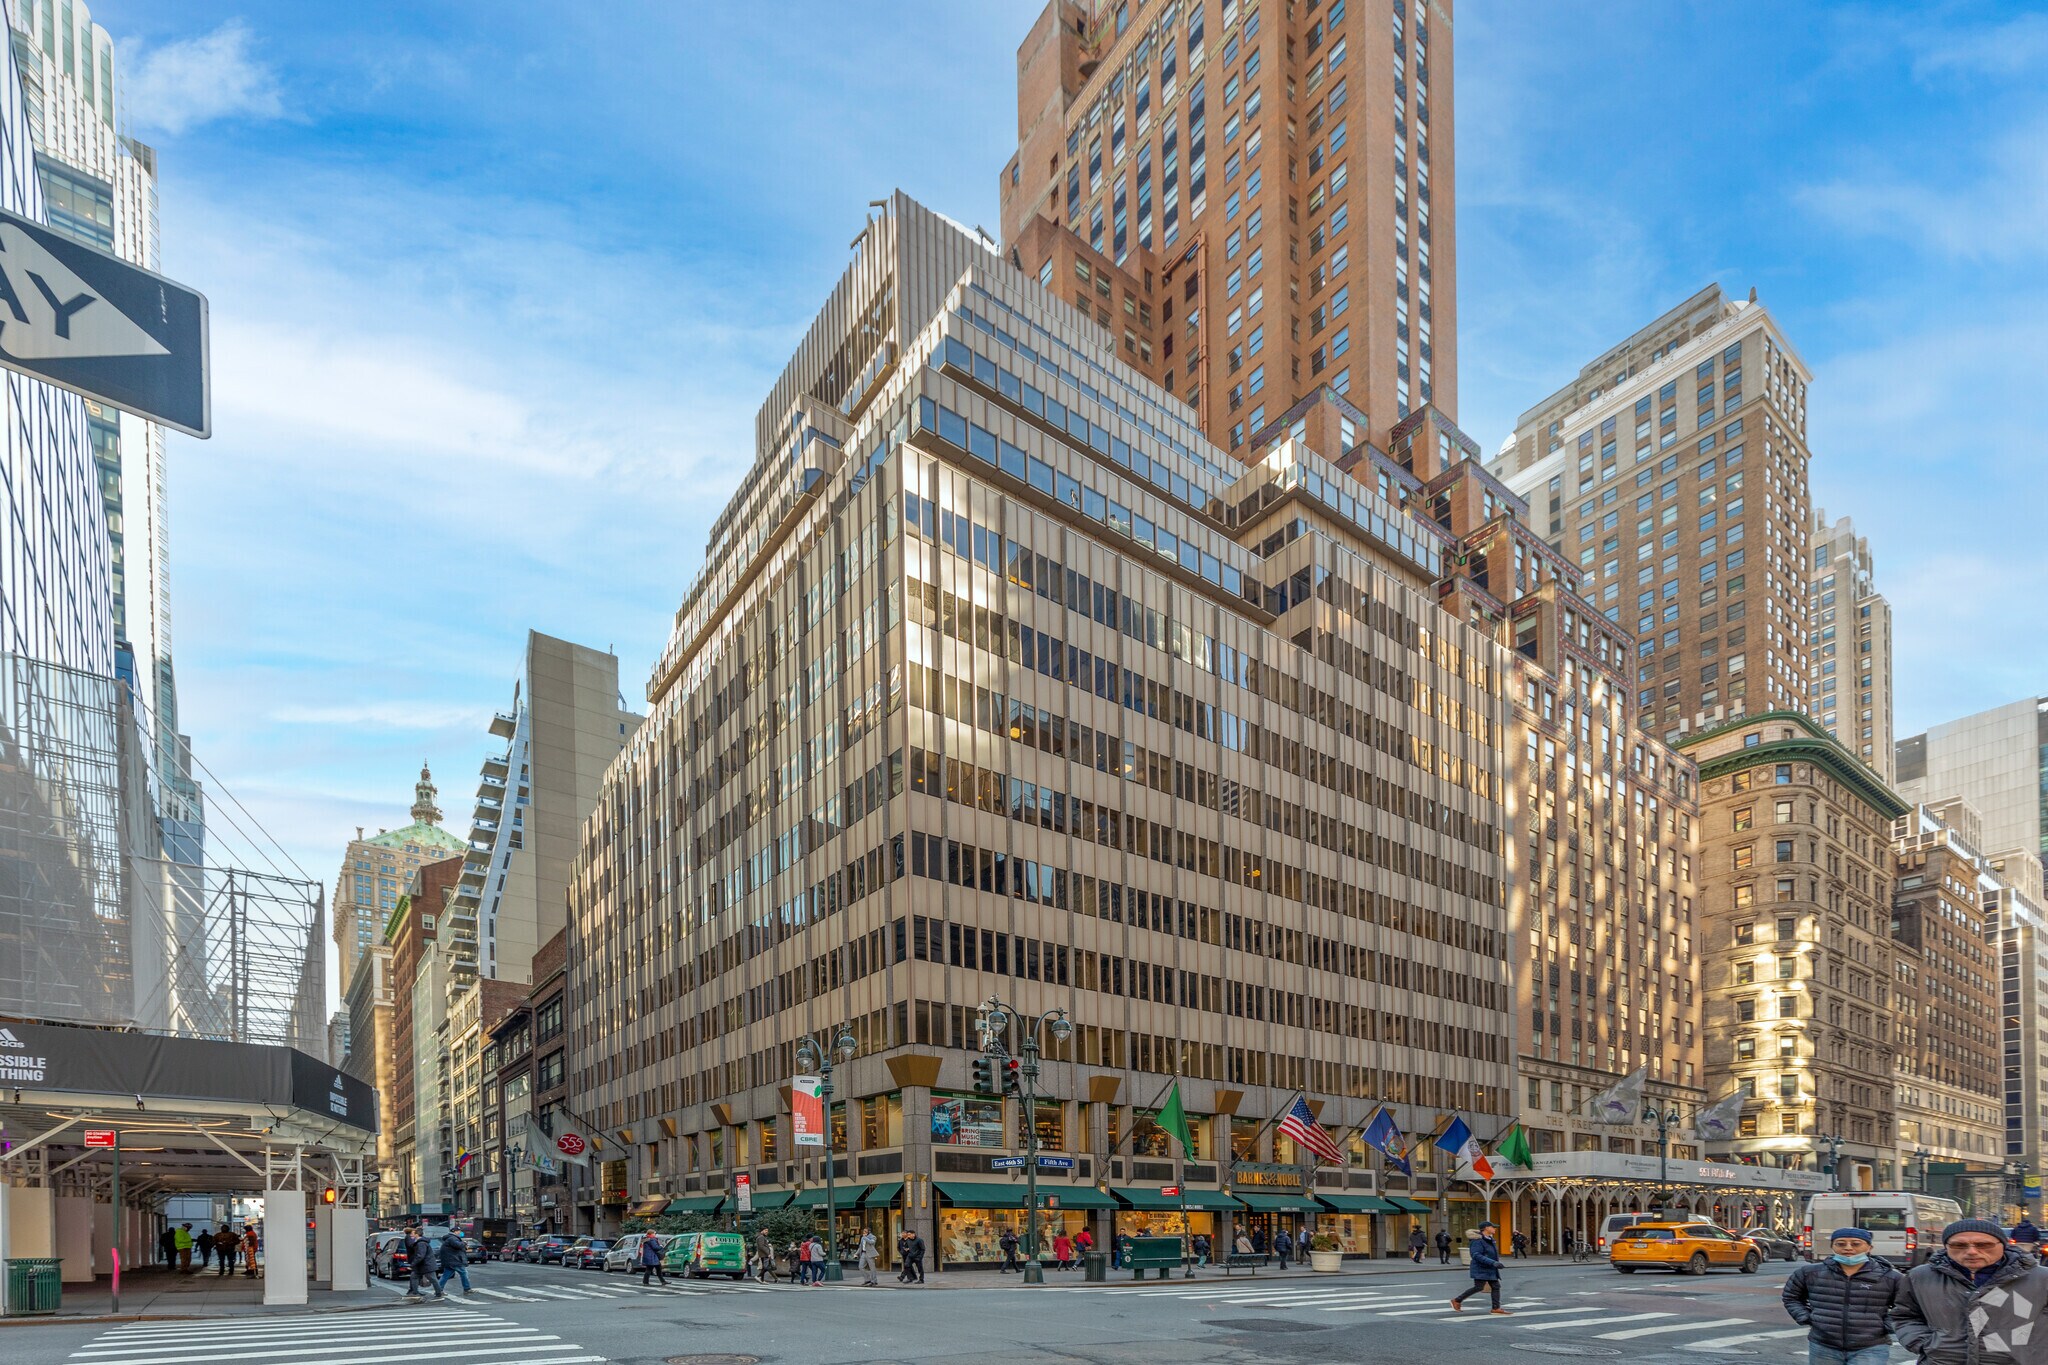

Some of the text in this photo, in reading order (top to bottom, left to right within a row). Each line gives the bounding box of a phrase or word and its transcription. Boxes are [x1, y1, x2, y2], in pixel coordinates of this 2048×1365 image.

[1546, 1115, 1563, 1126] THE
[1613, 1125, 1644, 1136] FRENCH
[1651, 1129, 1687, 1141] BUDING
[558, 1136, 582, 1150] 555
